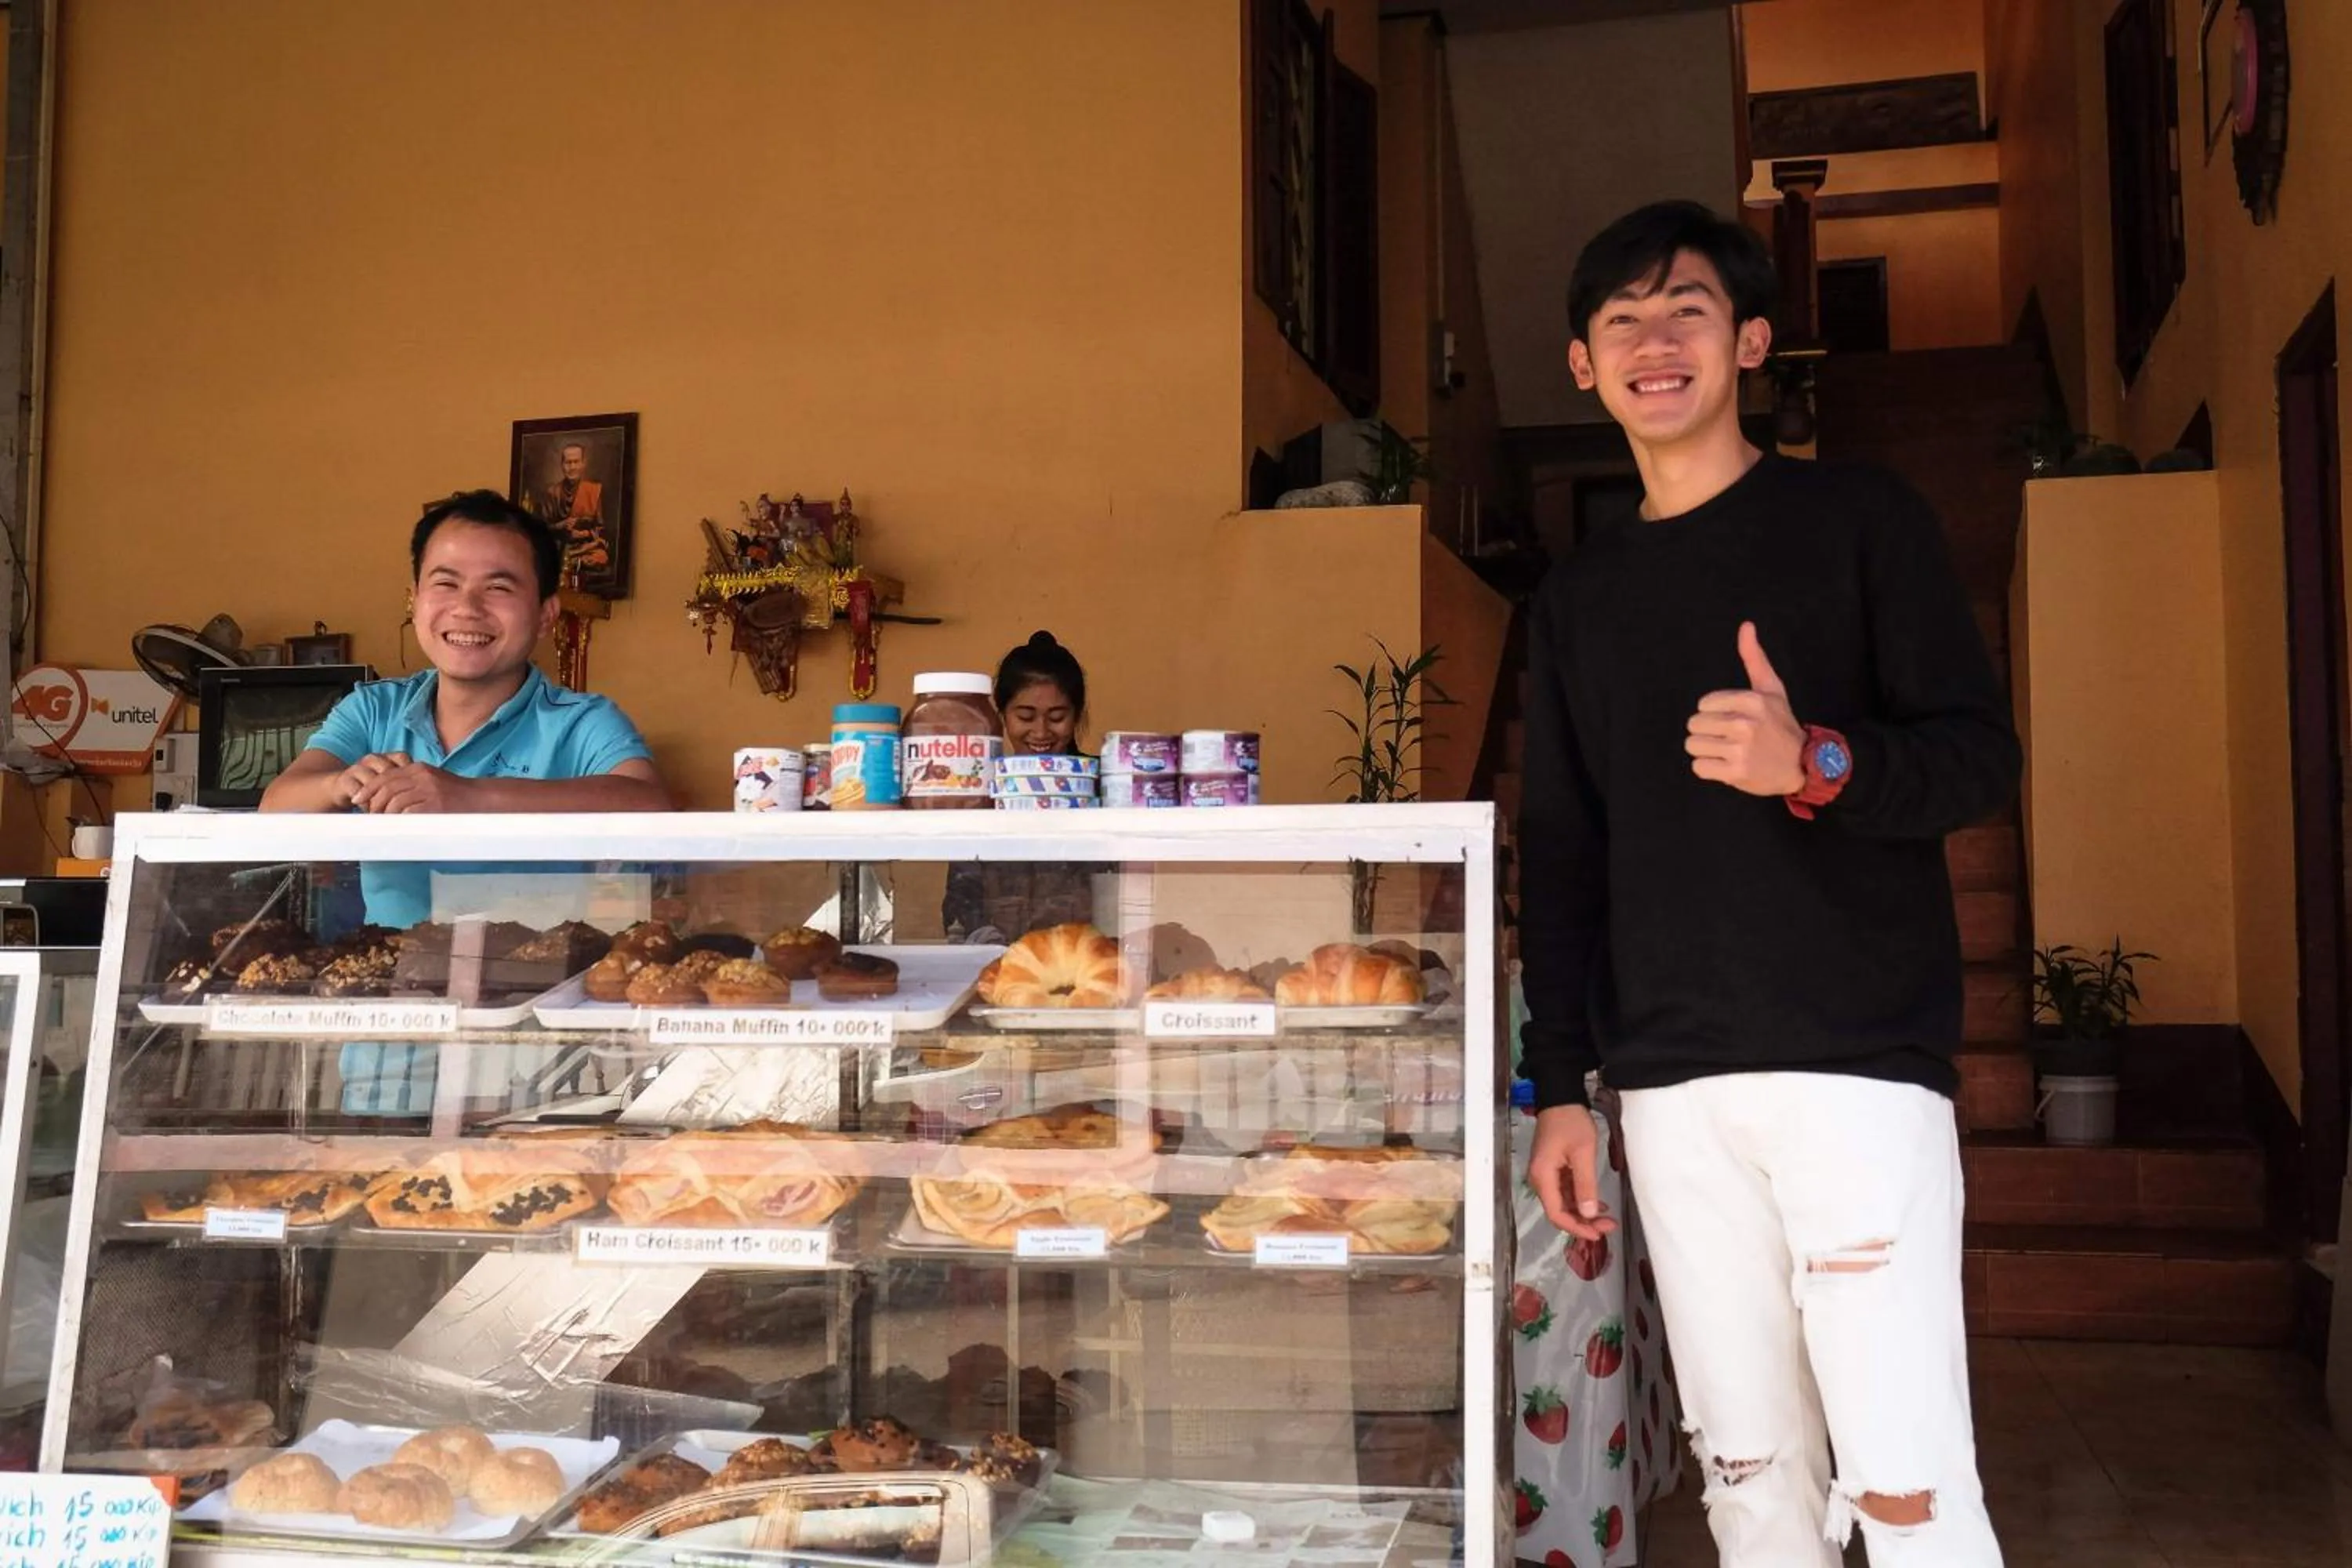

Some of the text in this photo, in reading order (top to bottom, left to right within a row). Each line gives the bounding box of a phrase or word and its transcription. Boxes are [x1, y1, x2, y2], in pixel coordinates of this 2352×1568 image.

[12, 684, 74, 721] 4G
[112, 706, 158, 724] unitel
[908, 734, 985, 758] nutella
[309, 1010, 361, 1026] Muffin
[657, 1017, 725, 1033] Banana
[733, 1018, 789, 1035] Muffin
[1162, 1011, 1259, 1029] Croissant
[587, 1232, 628, 1248] Ham
[635, 1233, 724, 1251] Croissant
[65, 1490, 94, 1523] 15
[0, 1523, 45, 1548] ich
[64, 1525, 88, 1551] 15
